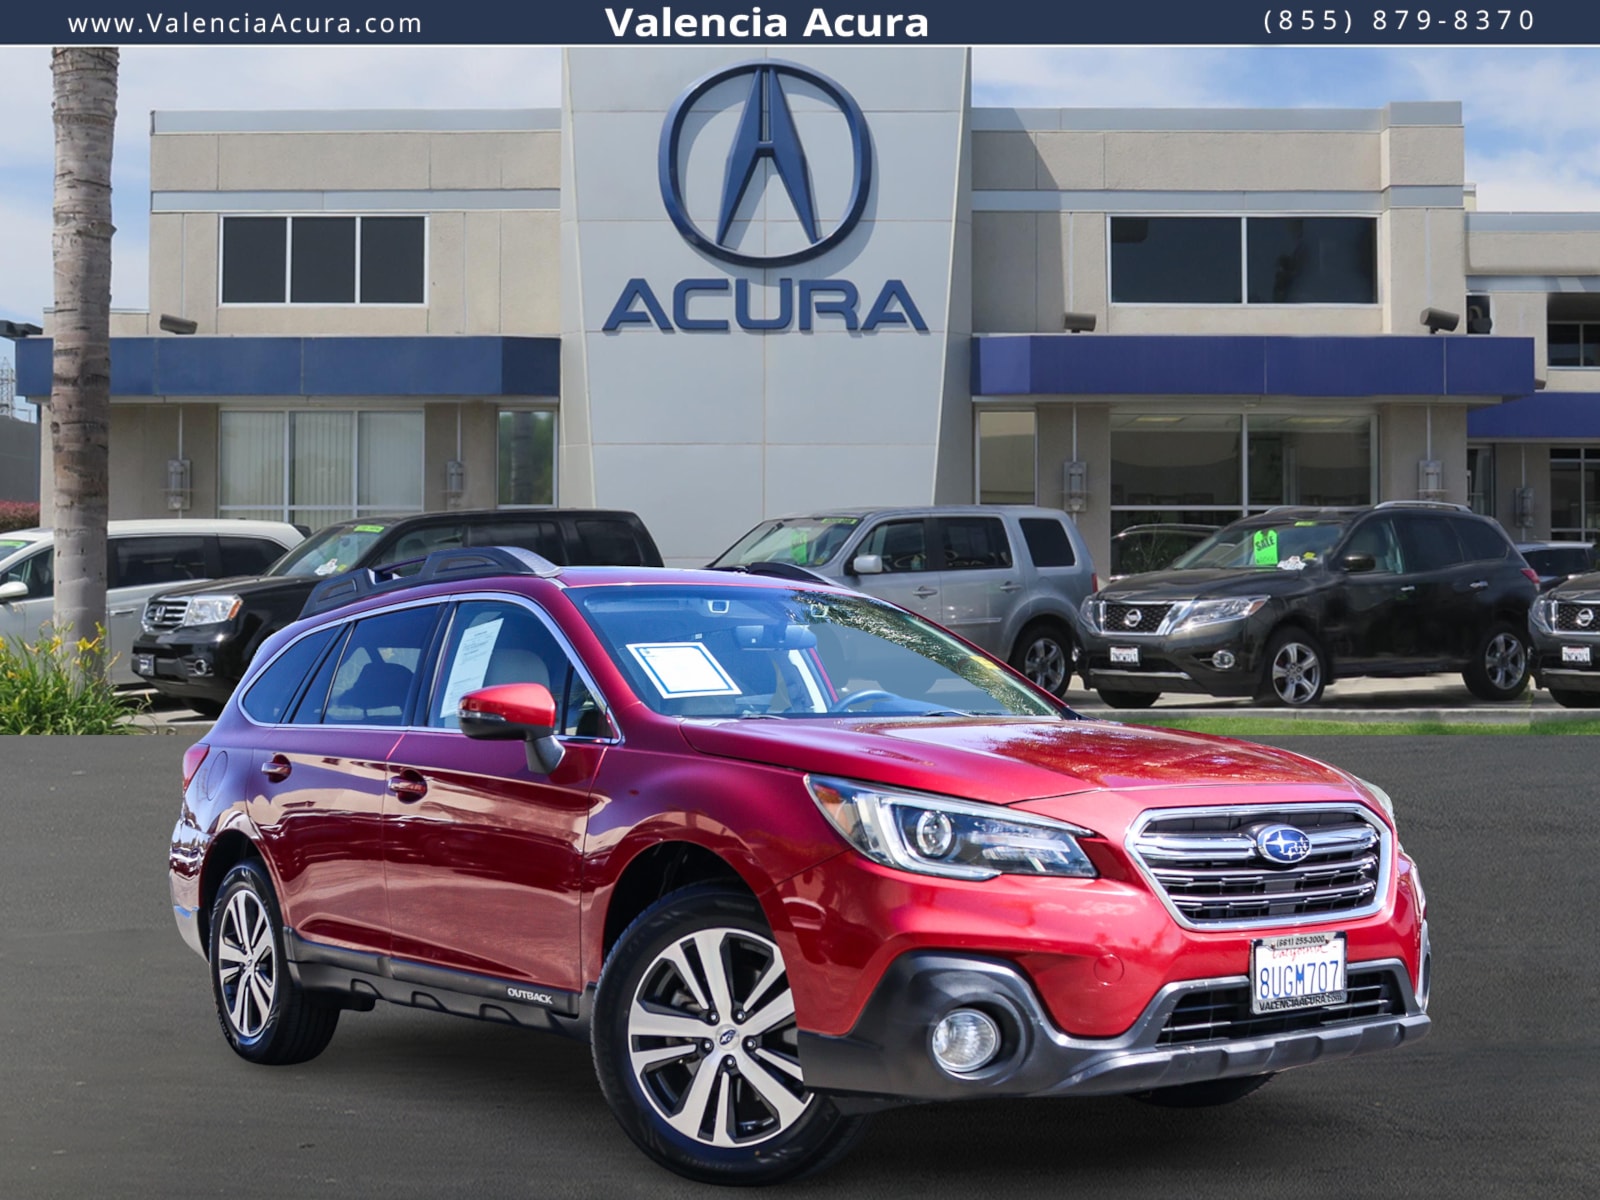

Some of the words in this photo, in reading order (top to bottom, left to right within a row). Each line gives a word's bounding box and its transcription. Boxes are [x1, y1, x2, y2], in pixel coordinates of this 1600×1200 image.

[604, 278, 928, 332] ACURA
[507, 988, 553, 1004] OUTBACK
[1260, 960, 1339, 999] 8UGM707
